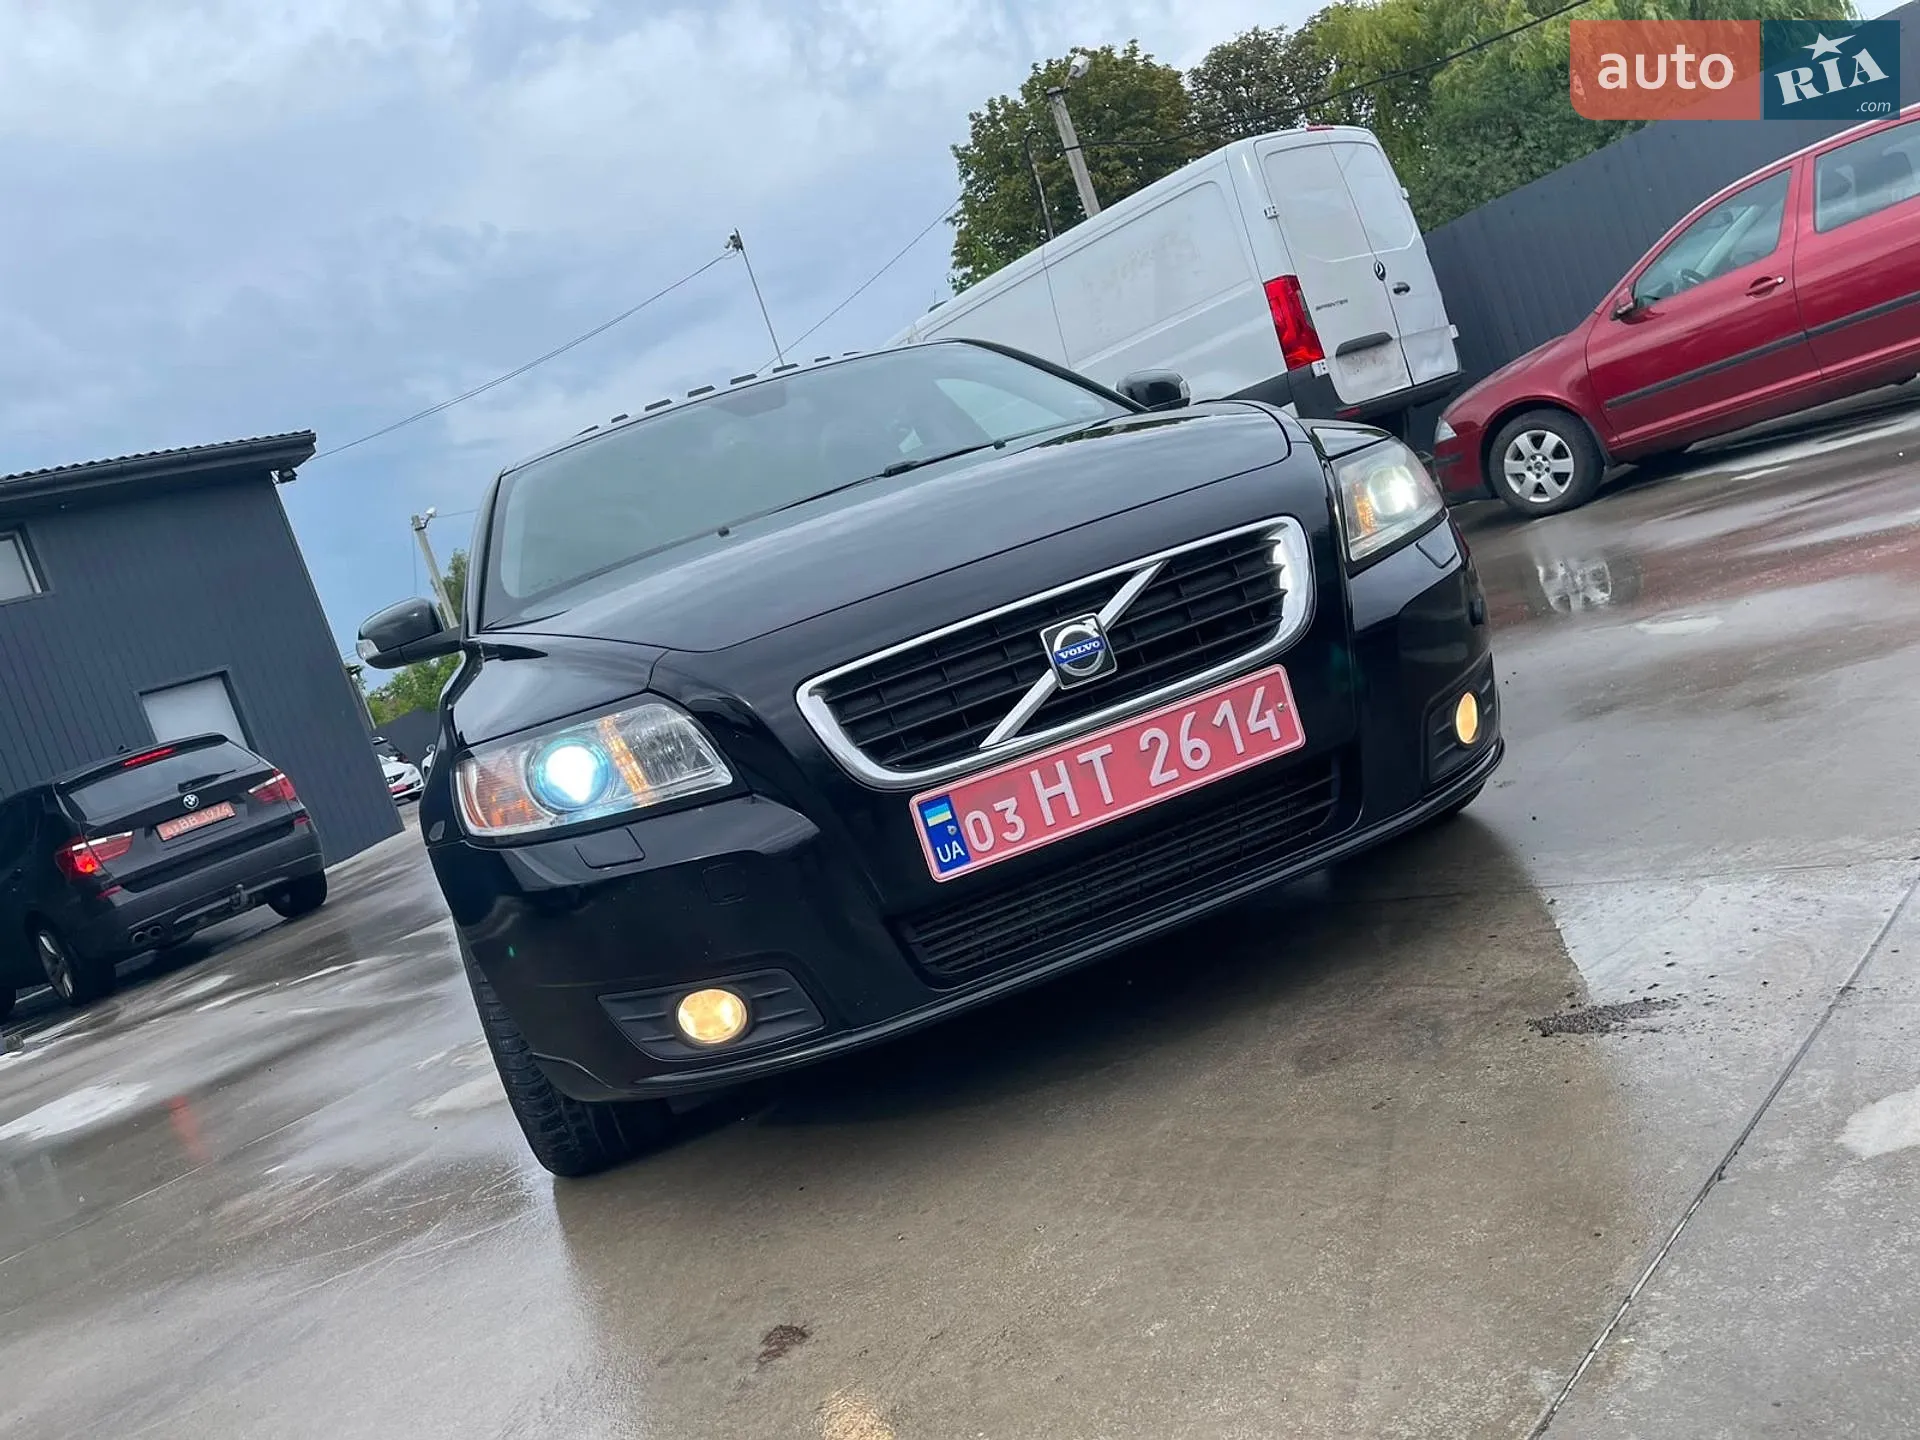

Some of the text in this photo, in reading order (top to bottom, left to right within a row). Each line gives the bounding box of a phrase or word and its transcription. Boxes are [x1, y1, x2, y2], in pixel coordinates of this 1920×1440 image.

[1058, 640, 1101, 659] VOLVO
[964, 685, 1282, 852] 03 HT 2614
[936, 840, 966, 863] UA
